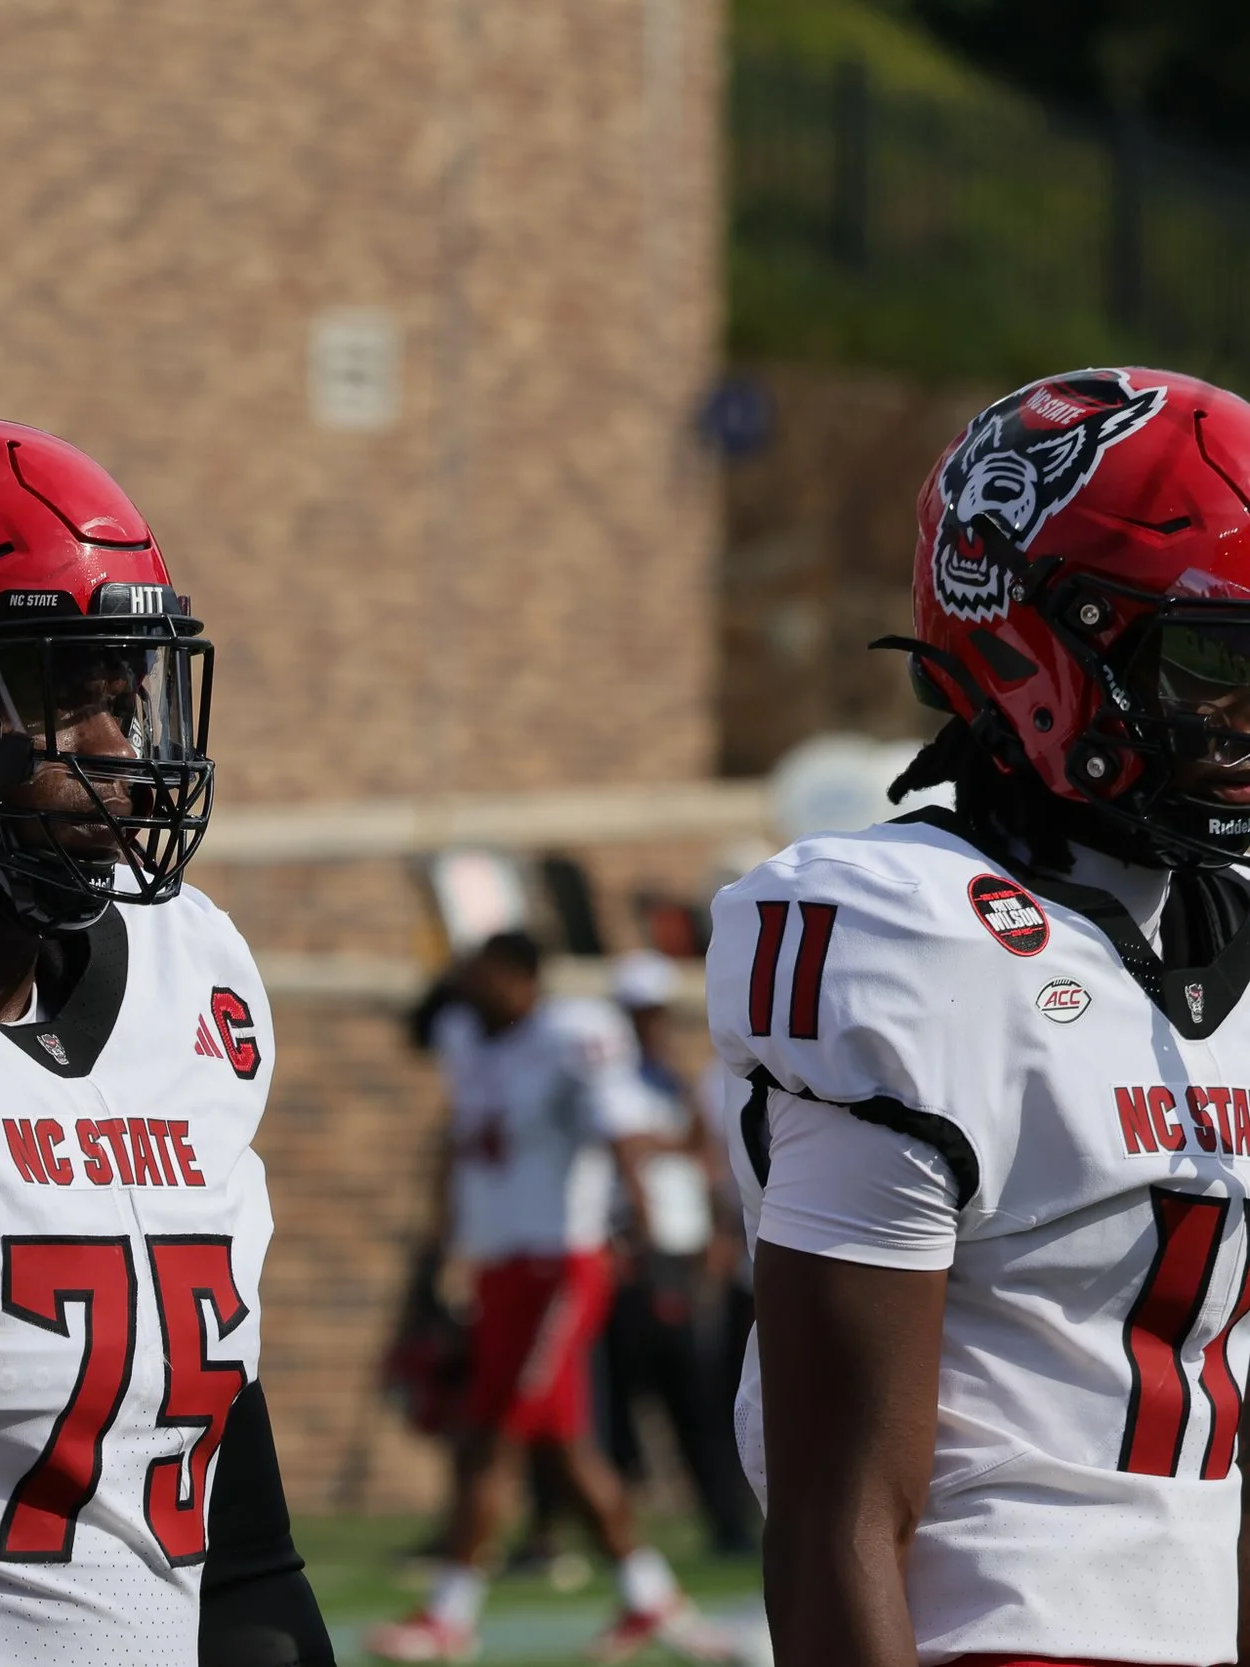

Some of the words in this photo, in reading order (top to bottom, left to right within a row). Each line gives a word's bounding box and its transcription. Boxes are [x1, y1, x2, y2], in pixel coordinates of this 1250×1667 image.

[1026, 386, 1052, 410] NC
[1036, 399, 1086, 425] STATE
[9, 594, 25, 606] NC
[26, 594, 59, 607] STATE
[131, 586, 163, 614] HTT
[985, 906, 1044, 932] WILSON
[749, 900, 838, 1040] 11
[1043, 989, 1083, 1008] ACC
[210, 986, 262, 1081] C
[1114, 1085, 1187, 1155] NC
[1185, 1085, 1250, 1157] STA
[2, 1118, 75, 1186] NC
[75, 1117, 207, 1187] STATE
